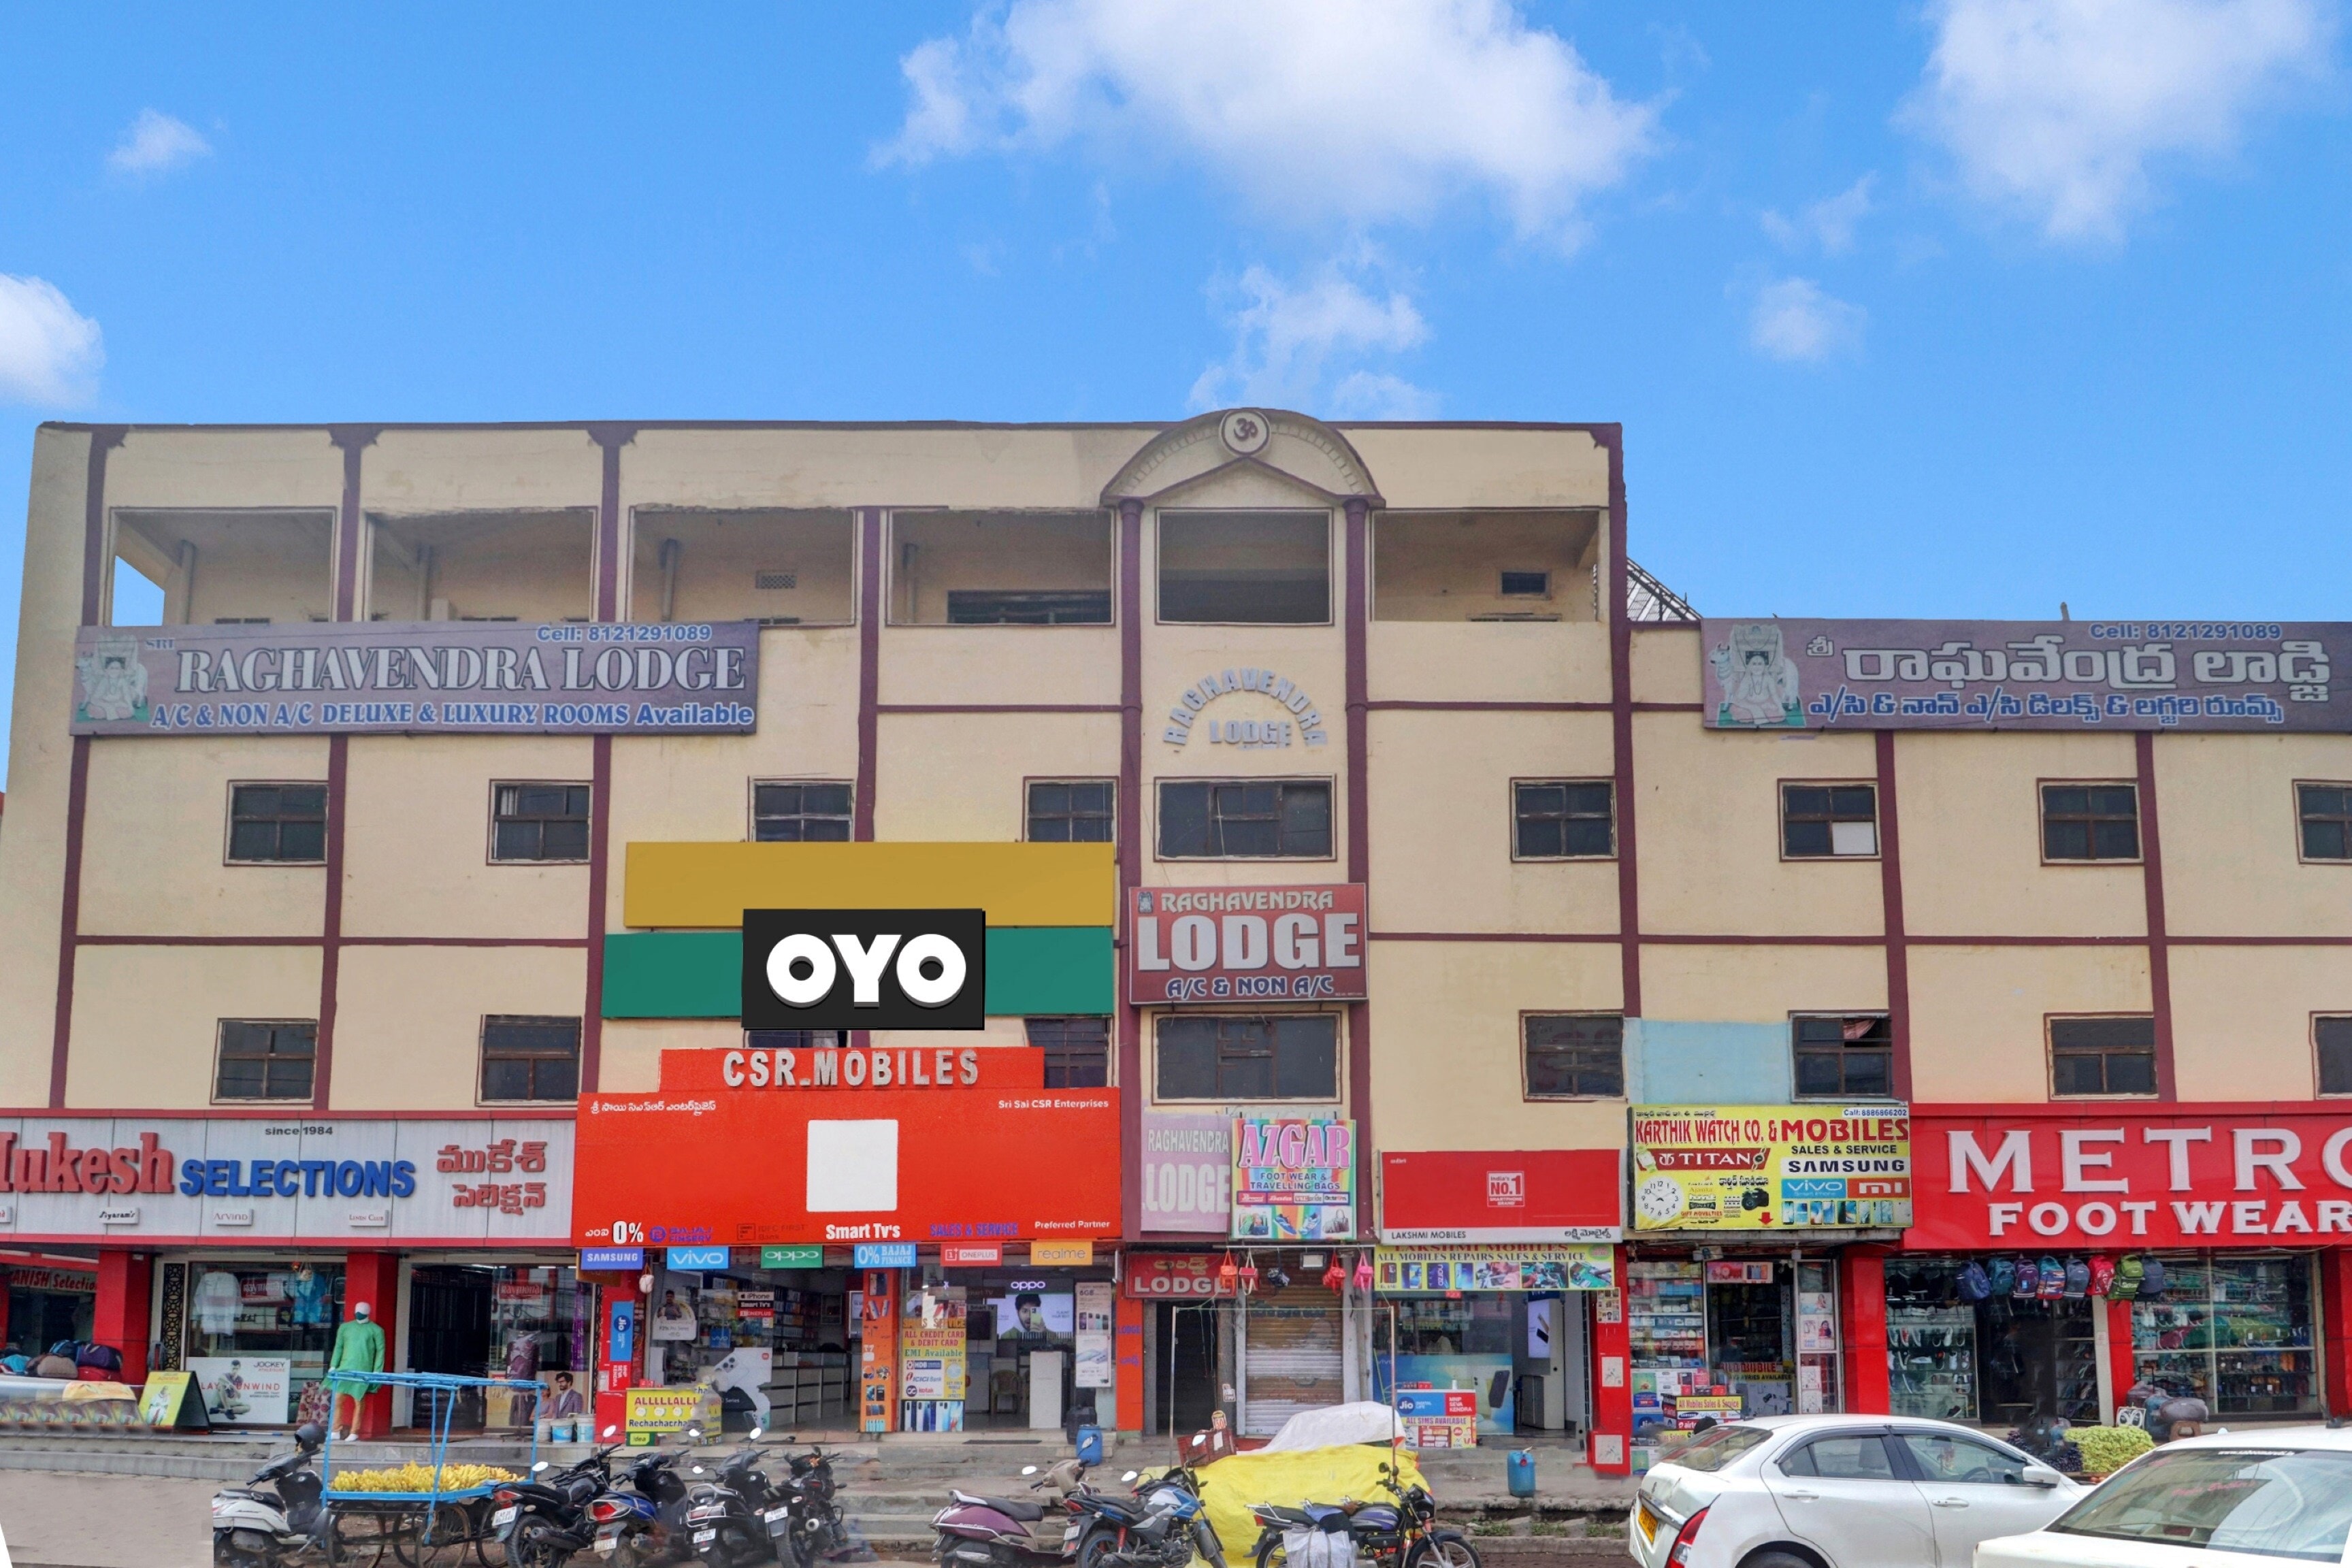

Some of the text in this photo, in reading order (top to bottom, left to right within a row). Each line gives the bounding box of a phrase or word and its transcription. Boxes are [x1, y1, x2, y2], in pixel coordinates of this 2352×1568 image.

[536, 625, 712, 642] Cell: 8121291089
[2089, 623, 2283, 640] Cell: 8121291089
[145, 638, 174, 649] SRI
[175, 647, 746, 693] RAGHAVENDRA LODGE
[1163, 668, 1327, 747] RAGHAVENDRA
[1873, 692, 1896, 715] &
[2106, 695, 2129, 716] &
[150, 702, 754, 729] A/C & NON A/C DELUXE & LUXURY ROOMS Available
[1209, 719, 1292, 747] LODGE
[1161, 890, 1333, 913] RAGHAVENDRA
[1138, 913, 1360, 971] LODGE
[766, 934, 966, 1008] OYO
[1166, 976, 1333, 999] A/C & NON A/C
[1032, 1100, 1051, 1108] CSR
[1054, 1100, 1109, 1108] Enterprises
[265, 1126, 333, 1136] since 1984
[1635, 1119, 1909, 1145] KARTHIK WATCH CO. & MOBILES
[1147, 1129, 1229, 1154] RAGHAVENDRA
[1238, 1124, 1351, 1169] AZGAR
[1791, 1145, 1897, 1154] SALES & SERVICE
[1678, 1153, 1751, 1166] TITAN
[1788, 1160, 1905, 1173] SAMSUNG
[180, 1159, 415, 1198] SELECTIONS
[1320, 1173, 1327, 1181] &
[1145, 1163, 1230, 1213] LODGE
[1787, 1179, 1842, 1191] vivo
[1034, 1220, 1111, 1229] Preferred Partner
[1989, 1200, 2352, 1235] FOOT WEAR
[612, 1220, 644, 1244] 0%
[826, 1223, 901, 1240] Smart Tv's
[930, 1223, 962, 1237] SALES
[976, 1222, 1019, 1237] SERVICE
[1392, 1230, 1467, 1239] LAKSHMI MOBILES
[881, 1245, 912, 1256] BAJAJ
[961, 1250, 997, 1259] ONEPLUS
[1037, 1247, 1086, 1260] realme
[1395, 1243, 1569, 1252] LAKSHMI MOBILES
[587, 1253, 638, 1262] SAMSUNG
[672, 1247, 723, 1265] vivo
[764, 1251, 819, 1261] oppo
[858, 1245, 880, 1265] 0%
[881, 1256, 912, 1265] FINANCE
[1541, 1252, 1586, 1260] SERVICE
[52, 1273, 97, 1290] Selectio
[1011, 1281, 1046, 1290] oppo
[618, 1317, 627, 1331] Jio
[925, 1349, 963, 1357] Available
[1399, 1401, 1414, 1409] Jio
[1686, 1399, 1703, 1408] Mobiles
[1704, 1399, 1716, 1408] Sales
[1722, 1399, 1739, 1408] Service
